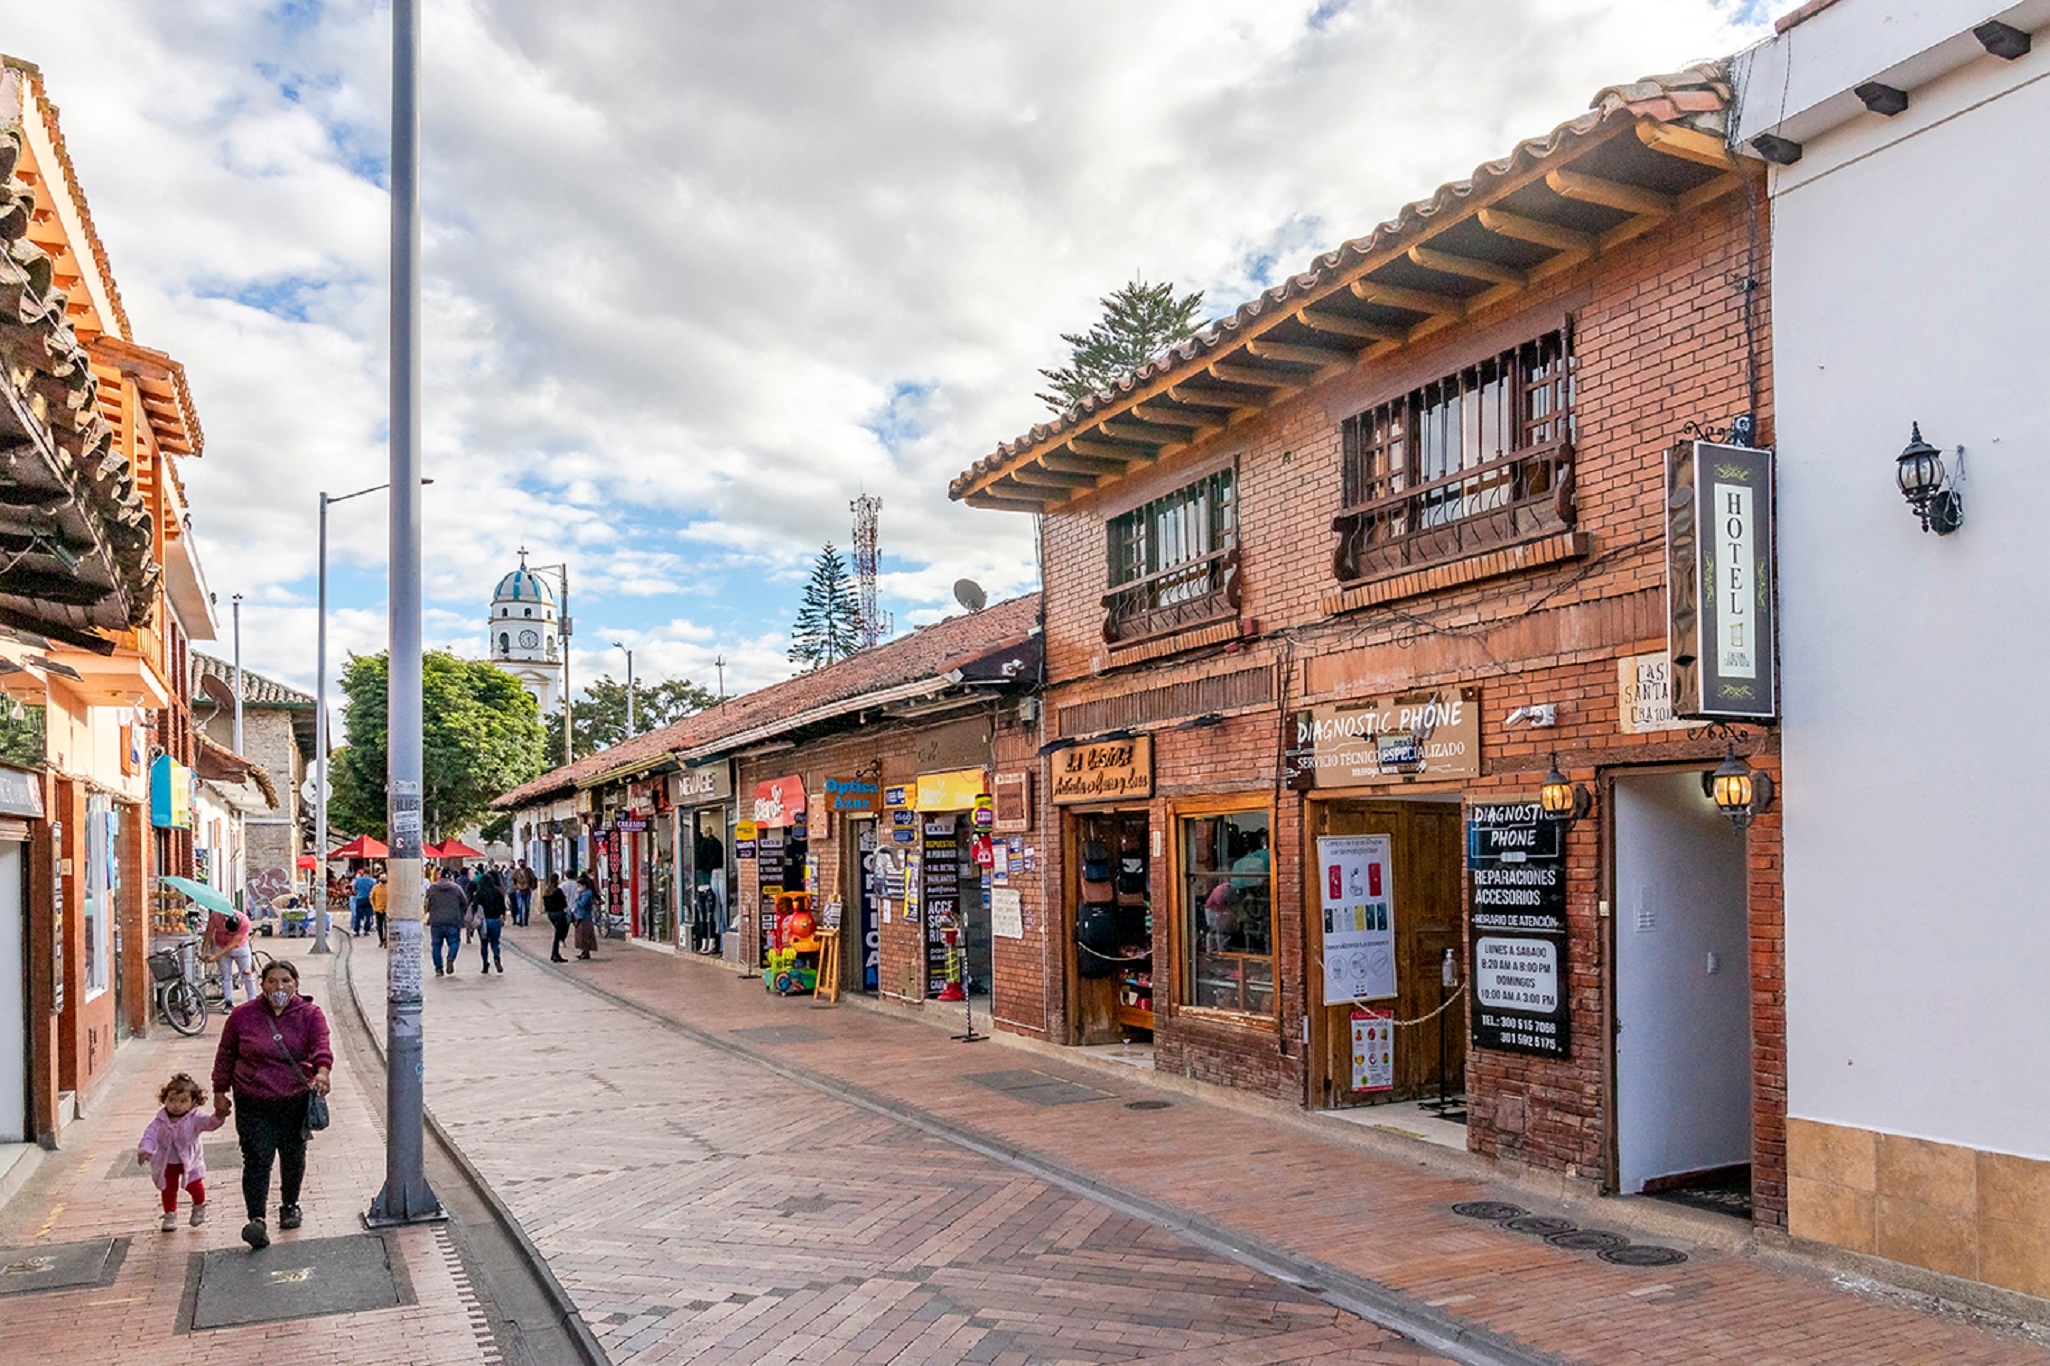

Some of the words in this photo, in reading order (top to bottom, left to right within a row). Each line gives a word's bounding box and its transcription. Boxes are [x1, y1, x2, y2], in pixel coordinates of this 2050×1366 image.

[1726, 491, 1743, 615] HOTEL
[1637, 662, 1669, 684] CAS
[1297, 711, 1391, 745] DIAGNOSTIC
[1399, 701, 1463, 732] PHONE
[1297, 755, 1338, 769] SERVICIO
[1340, 750, 1379, 766] TÉCNICO
[1383, 743, 1466, 763] ESPECIALIZADO
[833, 795, 870, 809] Azur
[1490, 830, 1537, 847] PHONE
[1474, 870, 1556, 885] REPARACIONES
[1474, 889, 1541, 906] ACCESORIOS
[1475, 914, 1507, 925] HORARIO
[1508, 915, 1518, 926] DE
[1484, 944, 1508, 955] LUNES
[1509, 945, 1515, 956] A
[1481, 959, 1498, 970] 8:20
[1499, 959, 1511, 970] AM
[1512, 960, 1518, 971] A
[1538, 963, 1551, 973] PM
[1496, 975, 1536, 988] DOMINGOS
[1481, 988, 1500, 999] 10:00
[1502, 990, 1514, 1000] AM
[1522, 992, 1540, 1004] 3:00
[1542, 994, 1555, 1006] PM
[1501, 1016, 1516, 1029] 300
[1518, 1018, 1533, 1031] 515
[1500, 1031, 1516, 1044] 301
[1518, 1033, 1533, 1047] 592
[1534, 1036, 1556, 1050] 5175
